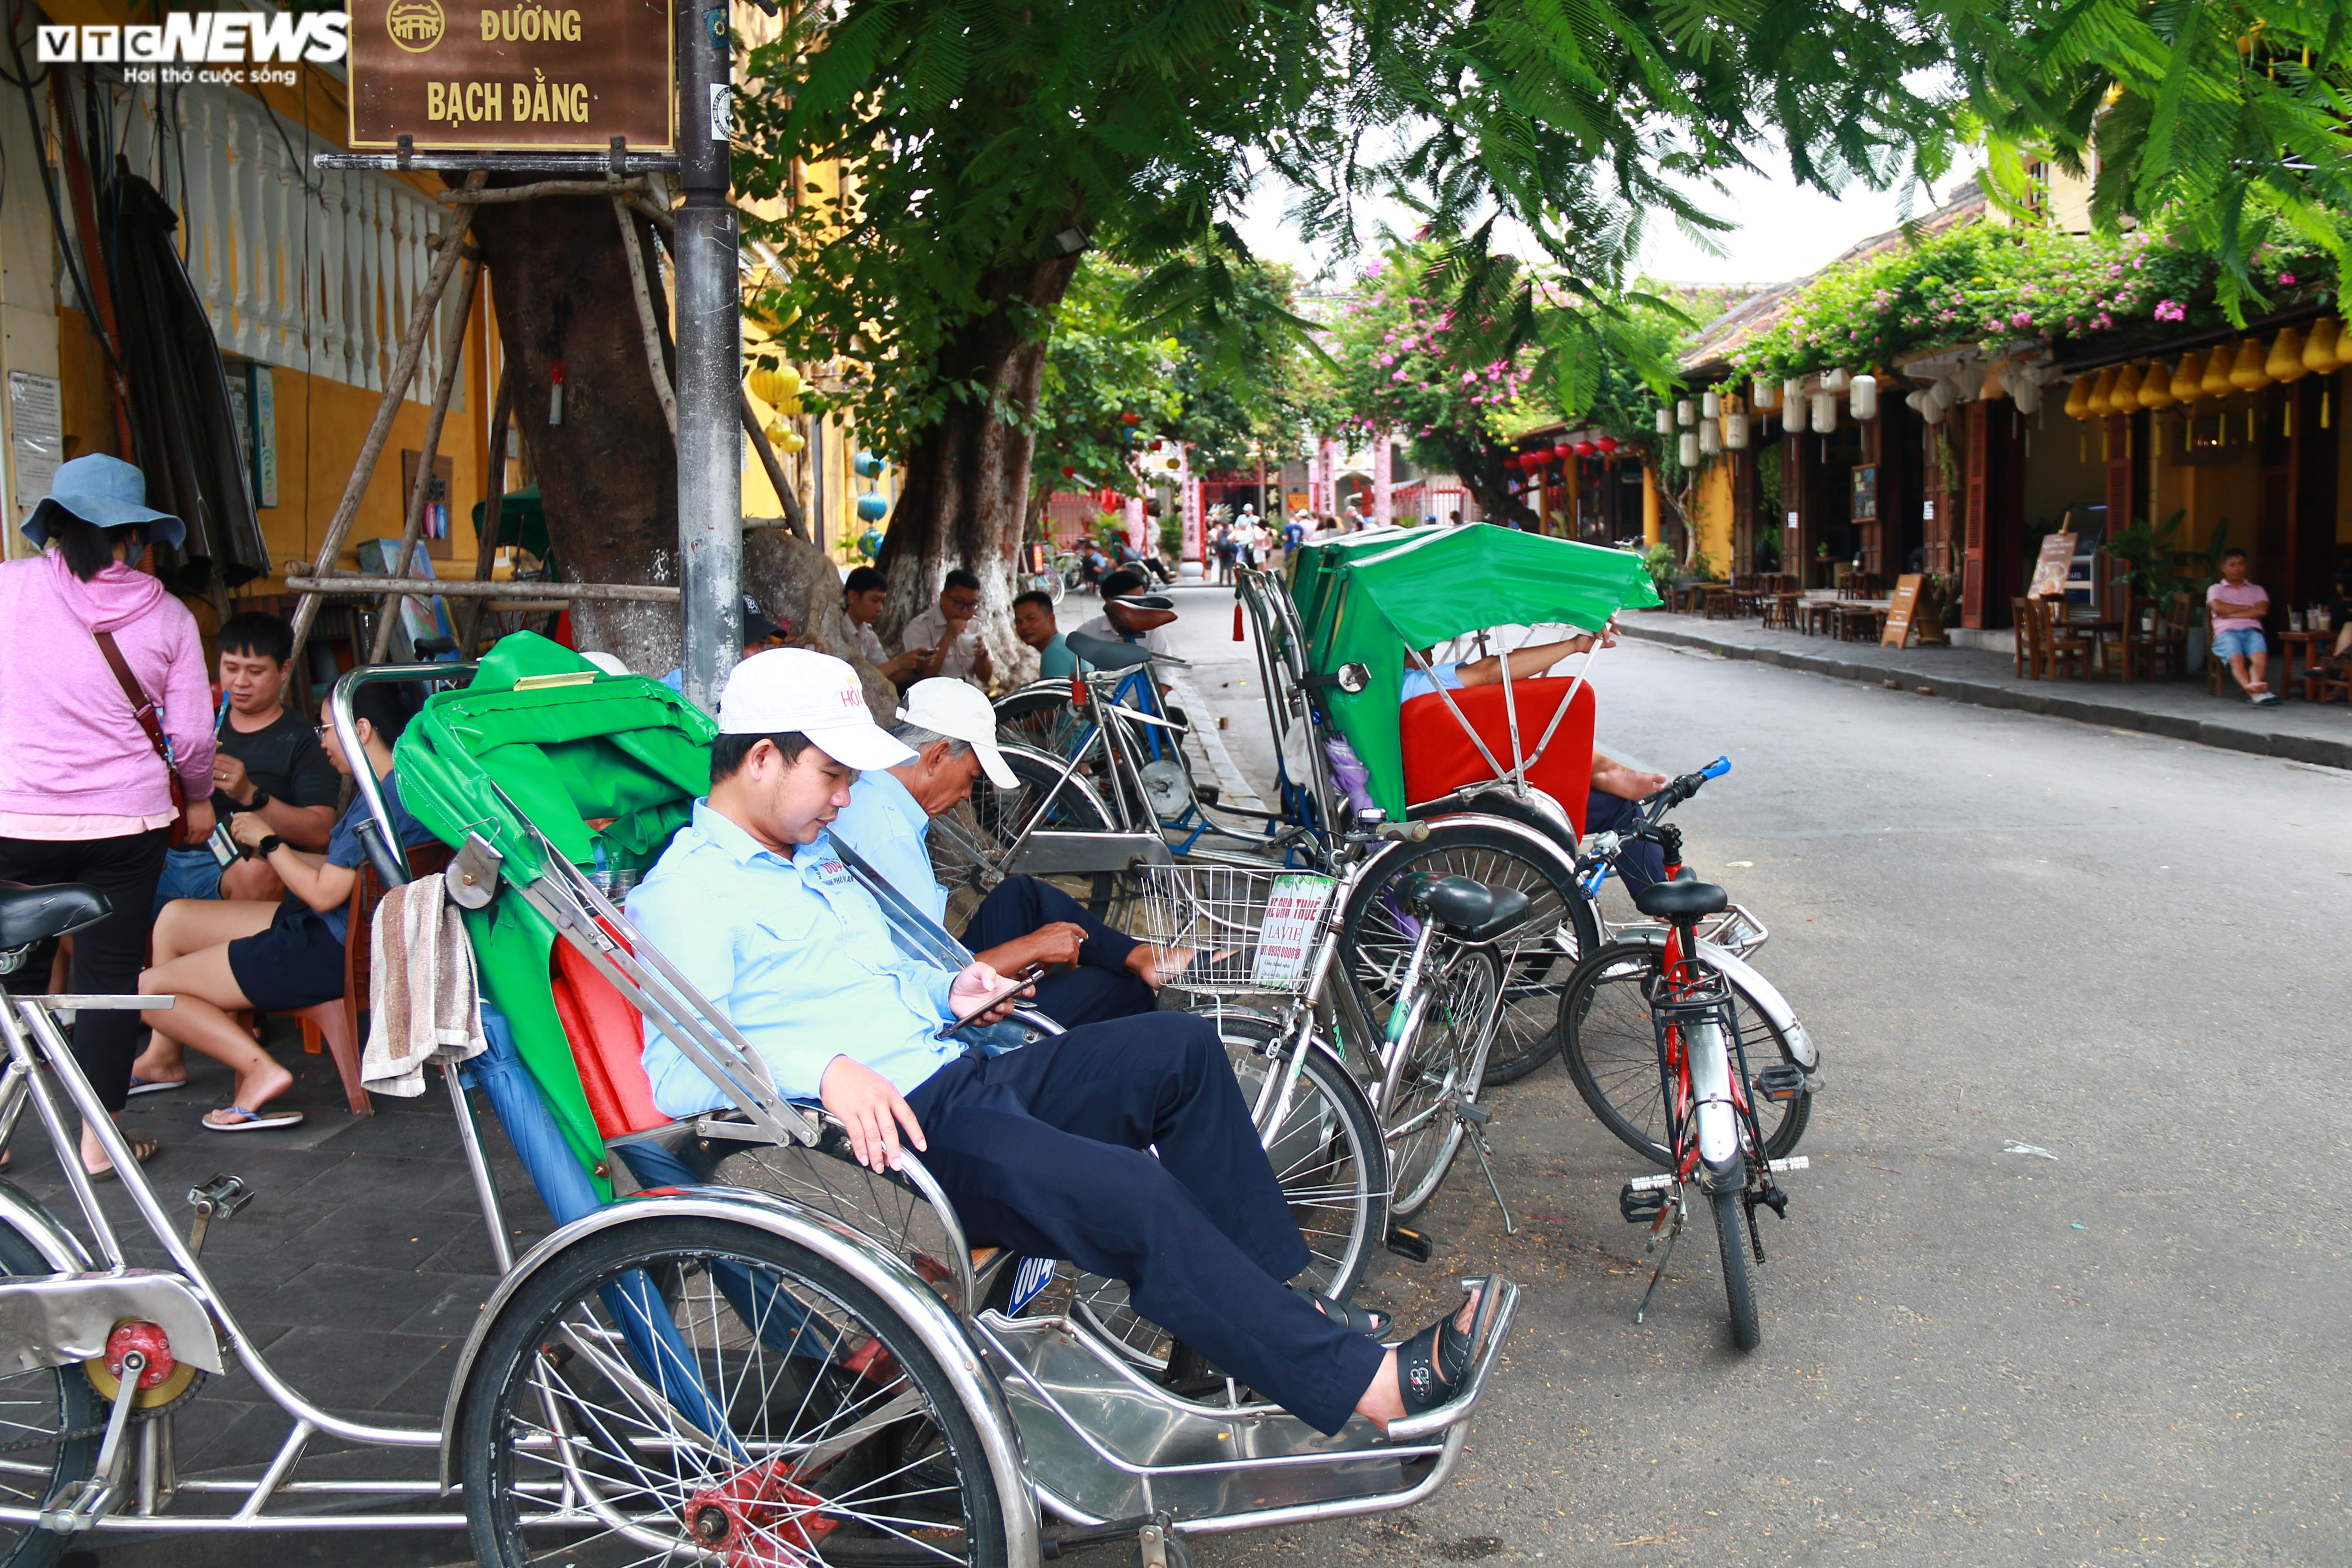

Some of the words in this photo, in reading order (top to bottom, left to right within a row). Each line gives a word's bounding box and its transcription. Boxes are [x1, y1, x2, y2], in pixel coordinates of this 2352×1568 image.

[481, 0, 581, 41] ĐƯỜNG
[428, 82, 502, 128] BẠCH
[512, 67, 588, 122] ĐẰNG
[1267, 897, 1278, 917] XE
[1276, 897, 1292, 918] CHO
[1293, 896, 1321, 921] THUÊ
